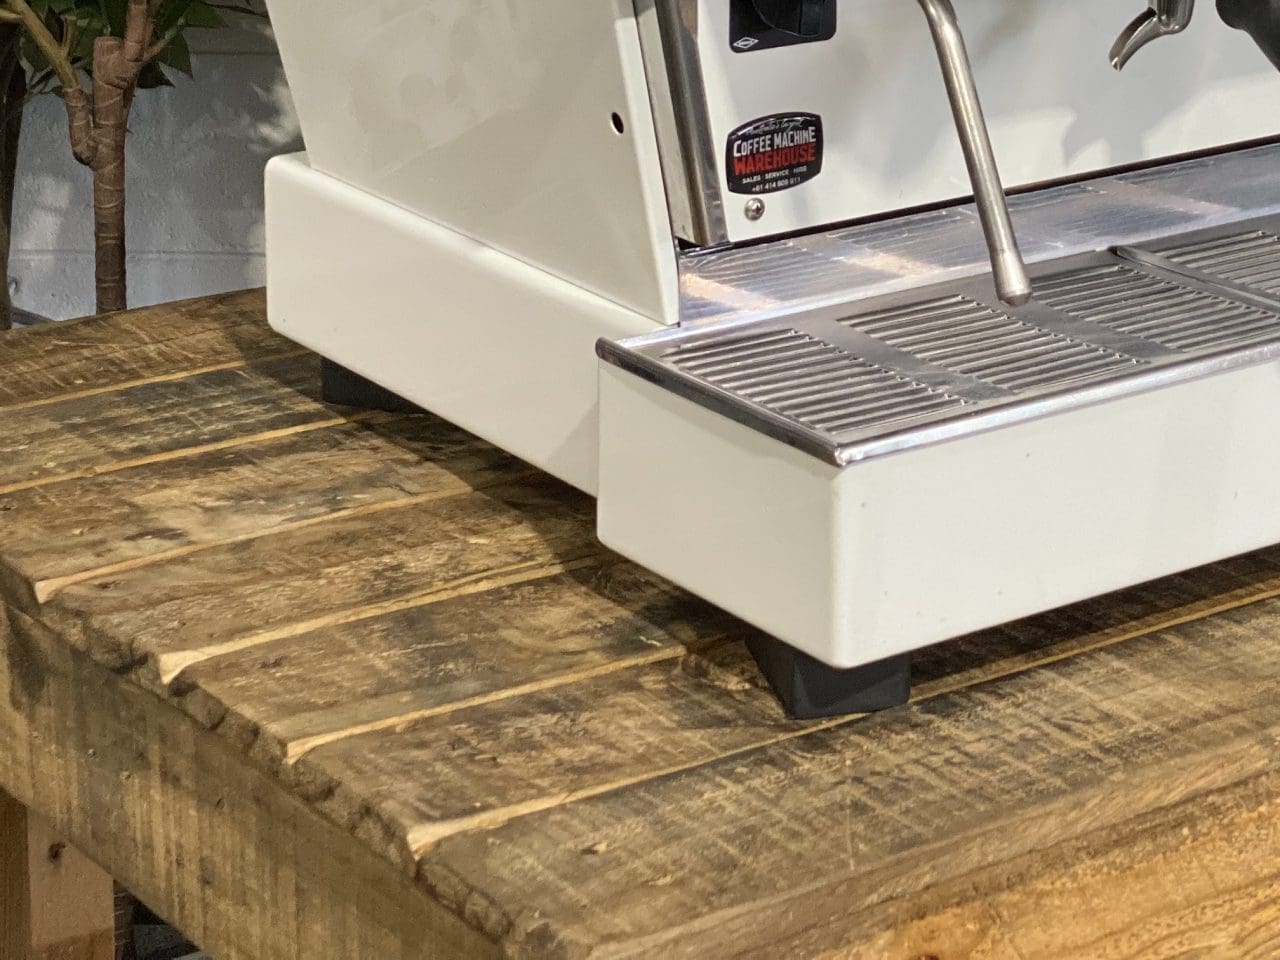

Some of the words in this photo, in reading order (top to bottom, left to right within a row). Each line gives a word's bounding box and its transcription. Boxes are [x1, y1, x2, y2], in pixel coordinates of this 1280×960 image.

[733, 134, 772, 158] COFFEE
[773, 126, 817, 149] MACHINE
[734, 141, 816, 176] WAREHOUSE
[742, 174, 761, 184] SALES
[765, 170, 790, 180] SERVICE
